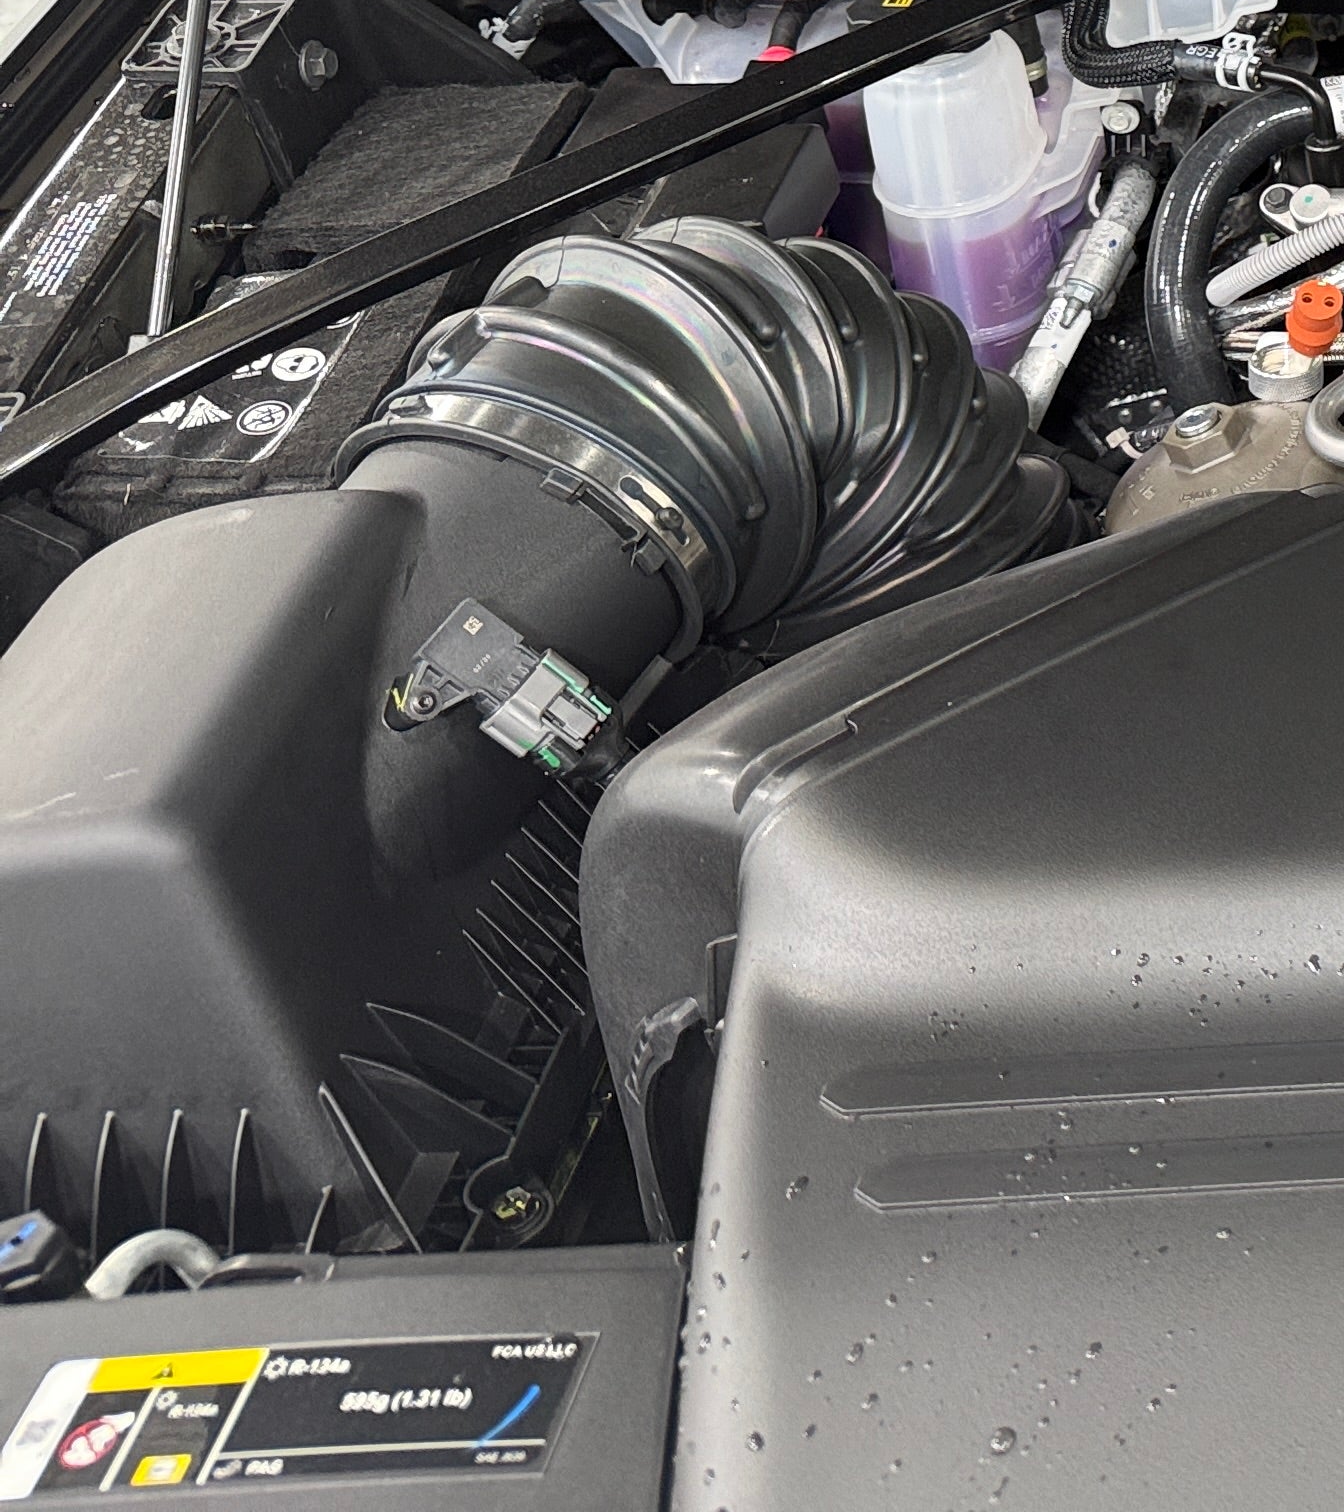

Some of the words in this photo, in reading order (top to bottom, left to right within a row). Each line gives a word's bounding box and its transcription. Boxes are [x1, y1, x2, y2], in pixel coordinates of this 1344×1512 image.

[1186, 45, 1218, 58] EGR
[492, 1345, 523, 1359] FCA
[288, 1358, 350, 1376] R-134a
